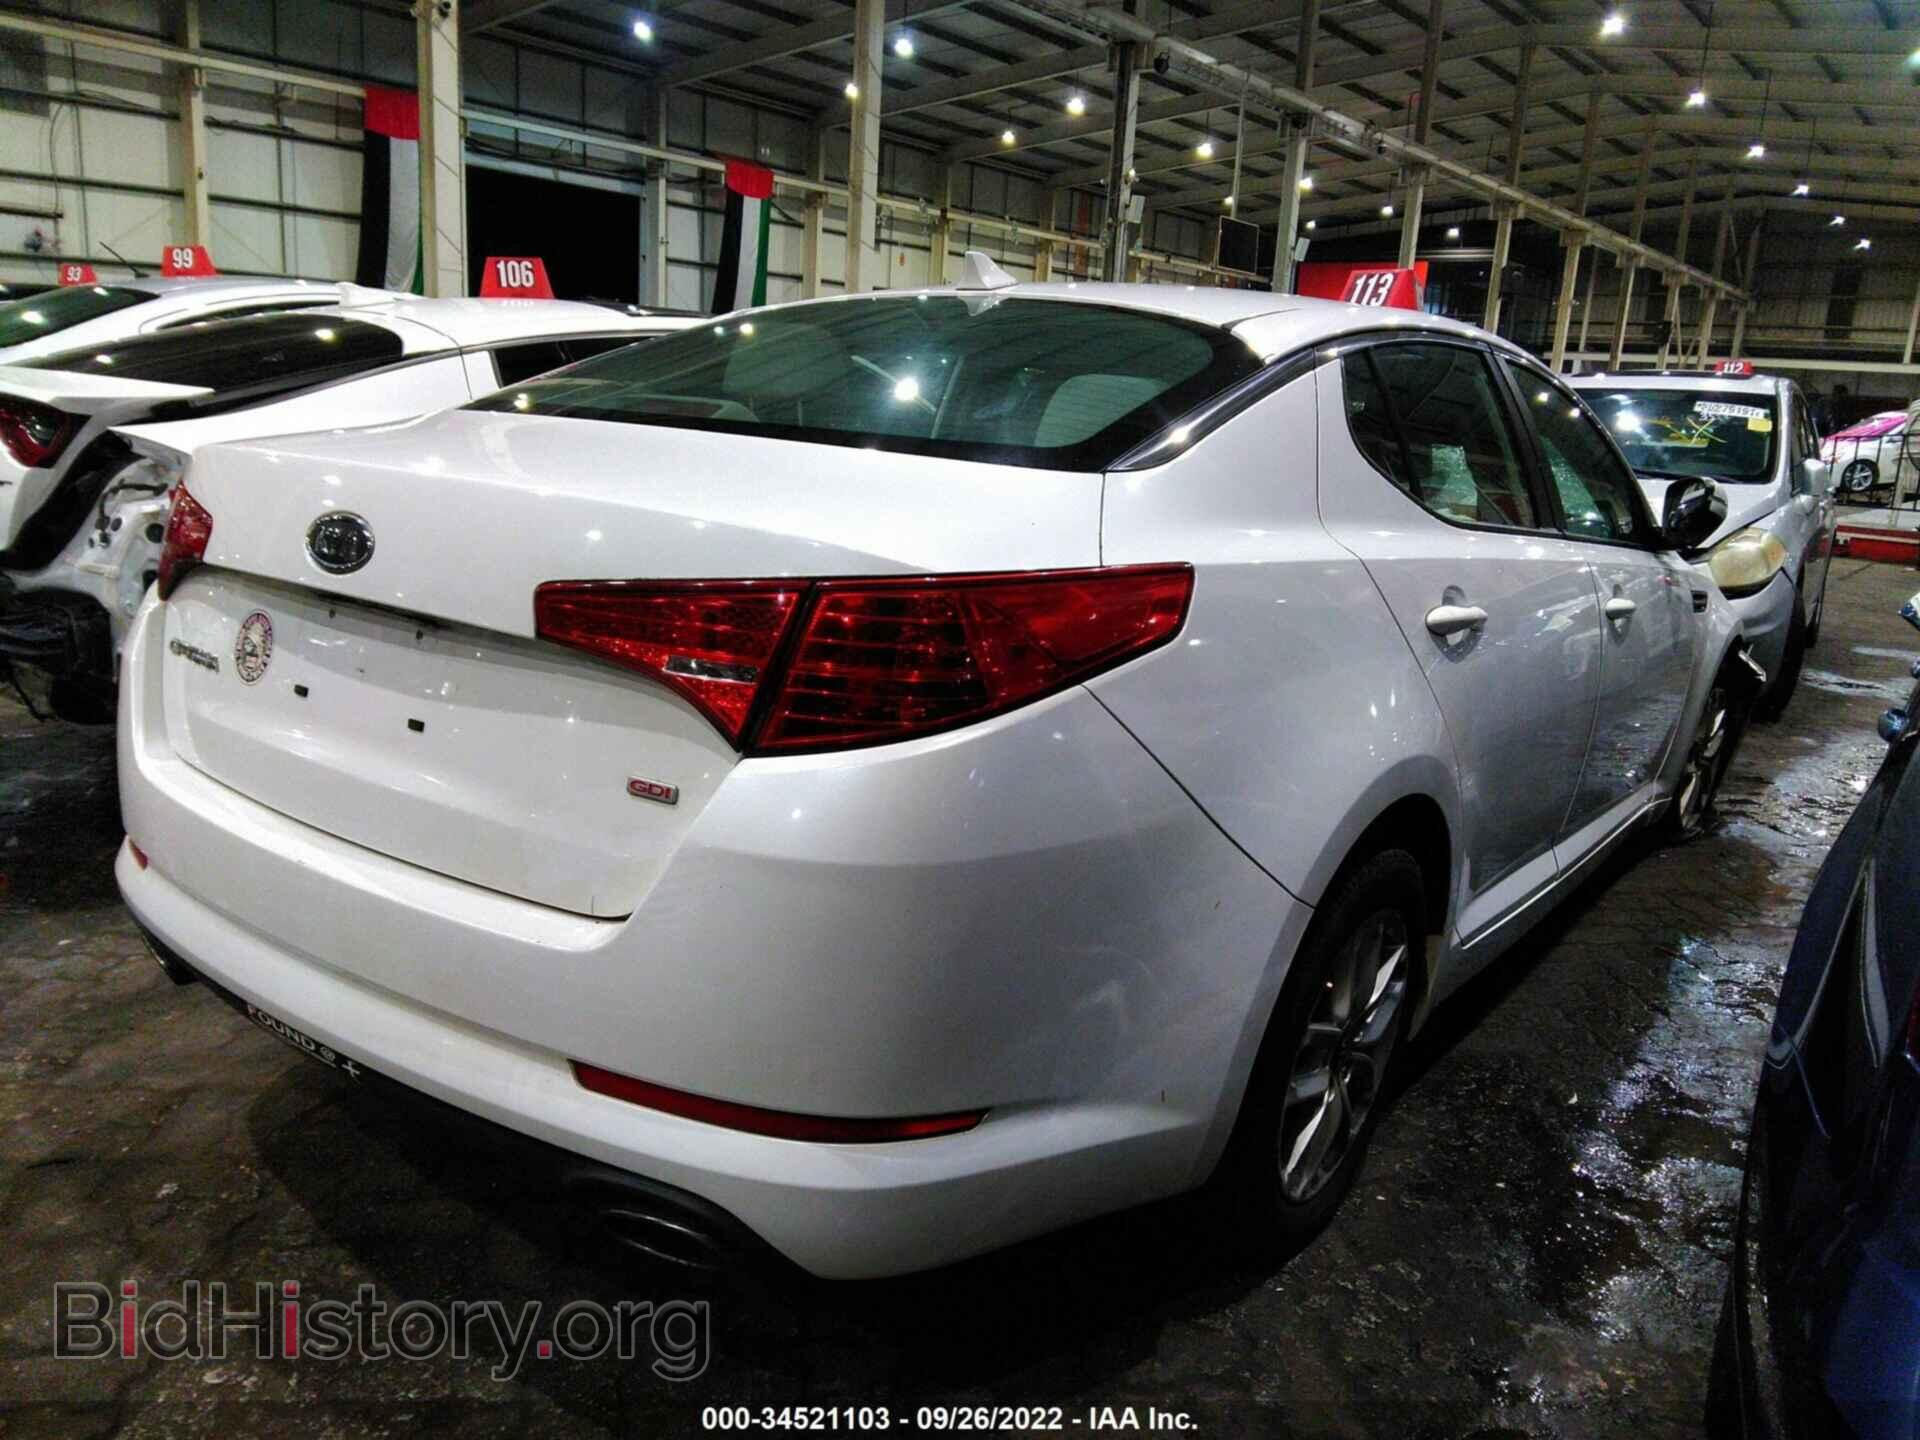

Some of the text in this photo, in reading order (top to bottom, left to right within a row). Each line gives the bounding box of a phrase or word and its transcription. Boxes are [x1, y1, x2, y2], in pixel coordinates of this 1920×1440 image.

[172, 247, 194, 269] 99
[66, 265, 82, 282] 93
[496, 260, 535, 288] 106
[1350, 271, 1395, 307] 113
[629, 780, 673, 799] GDI
